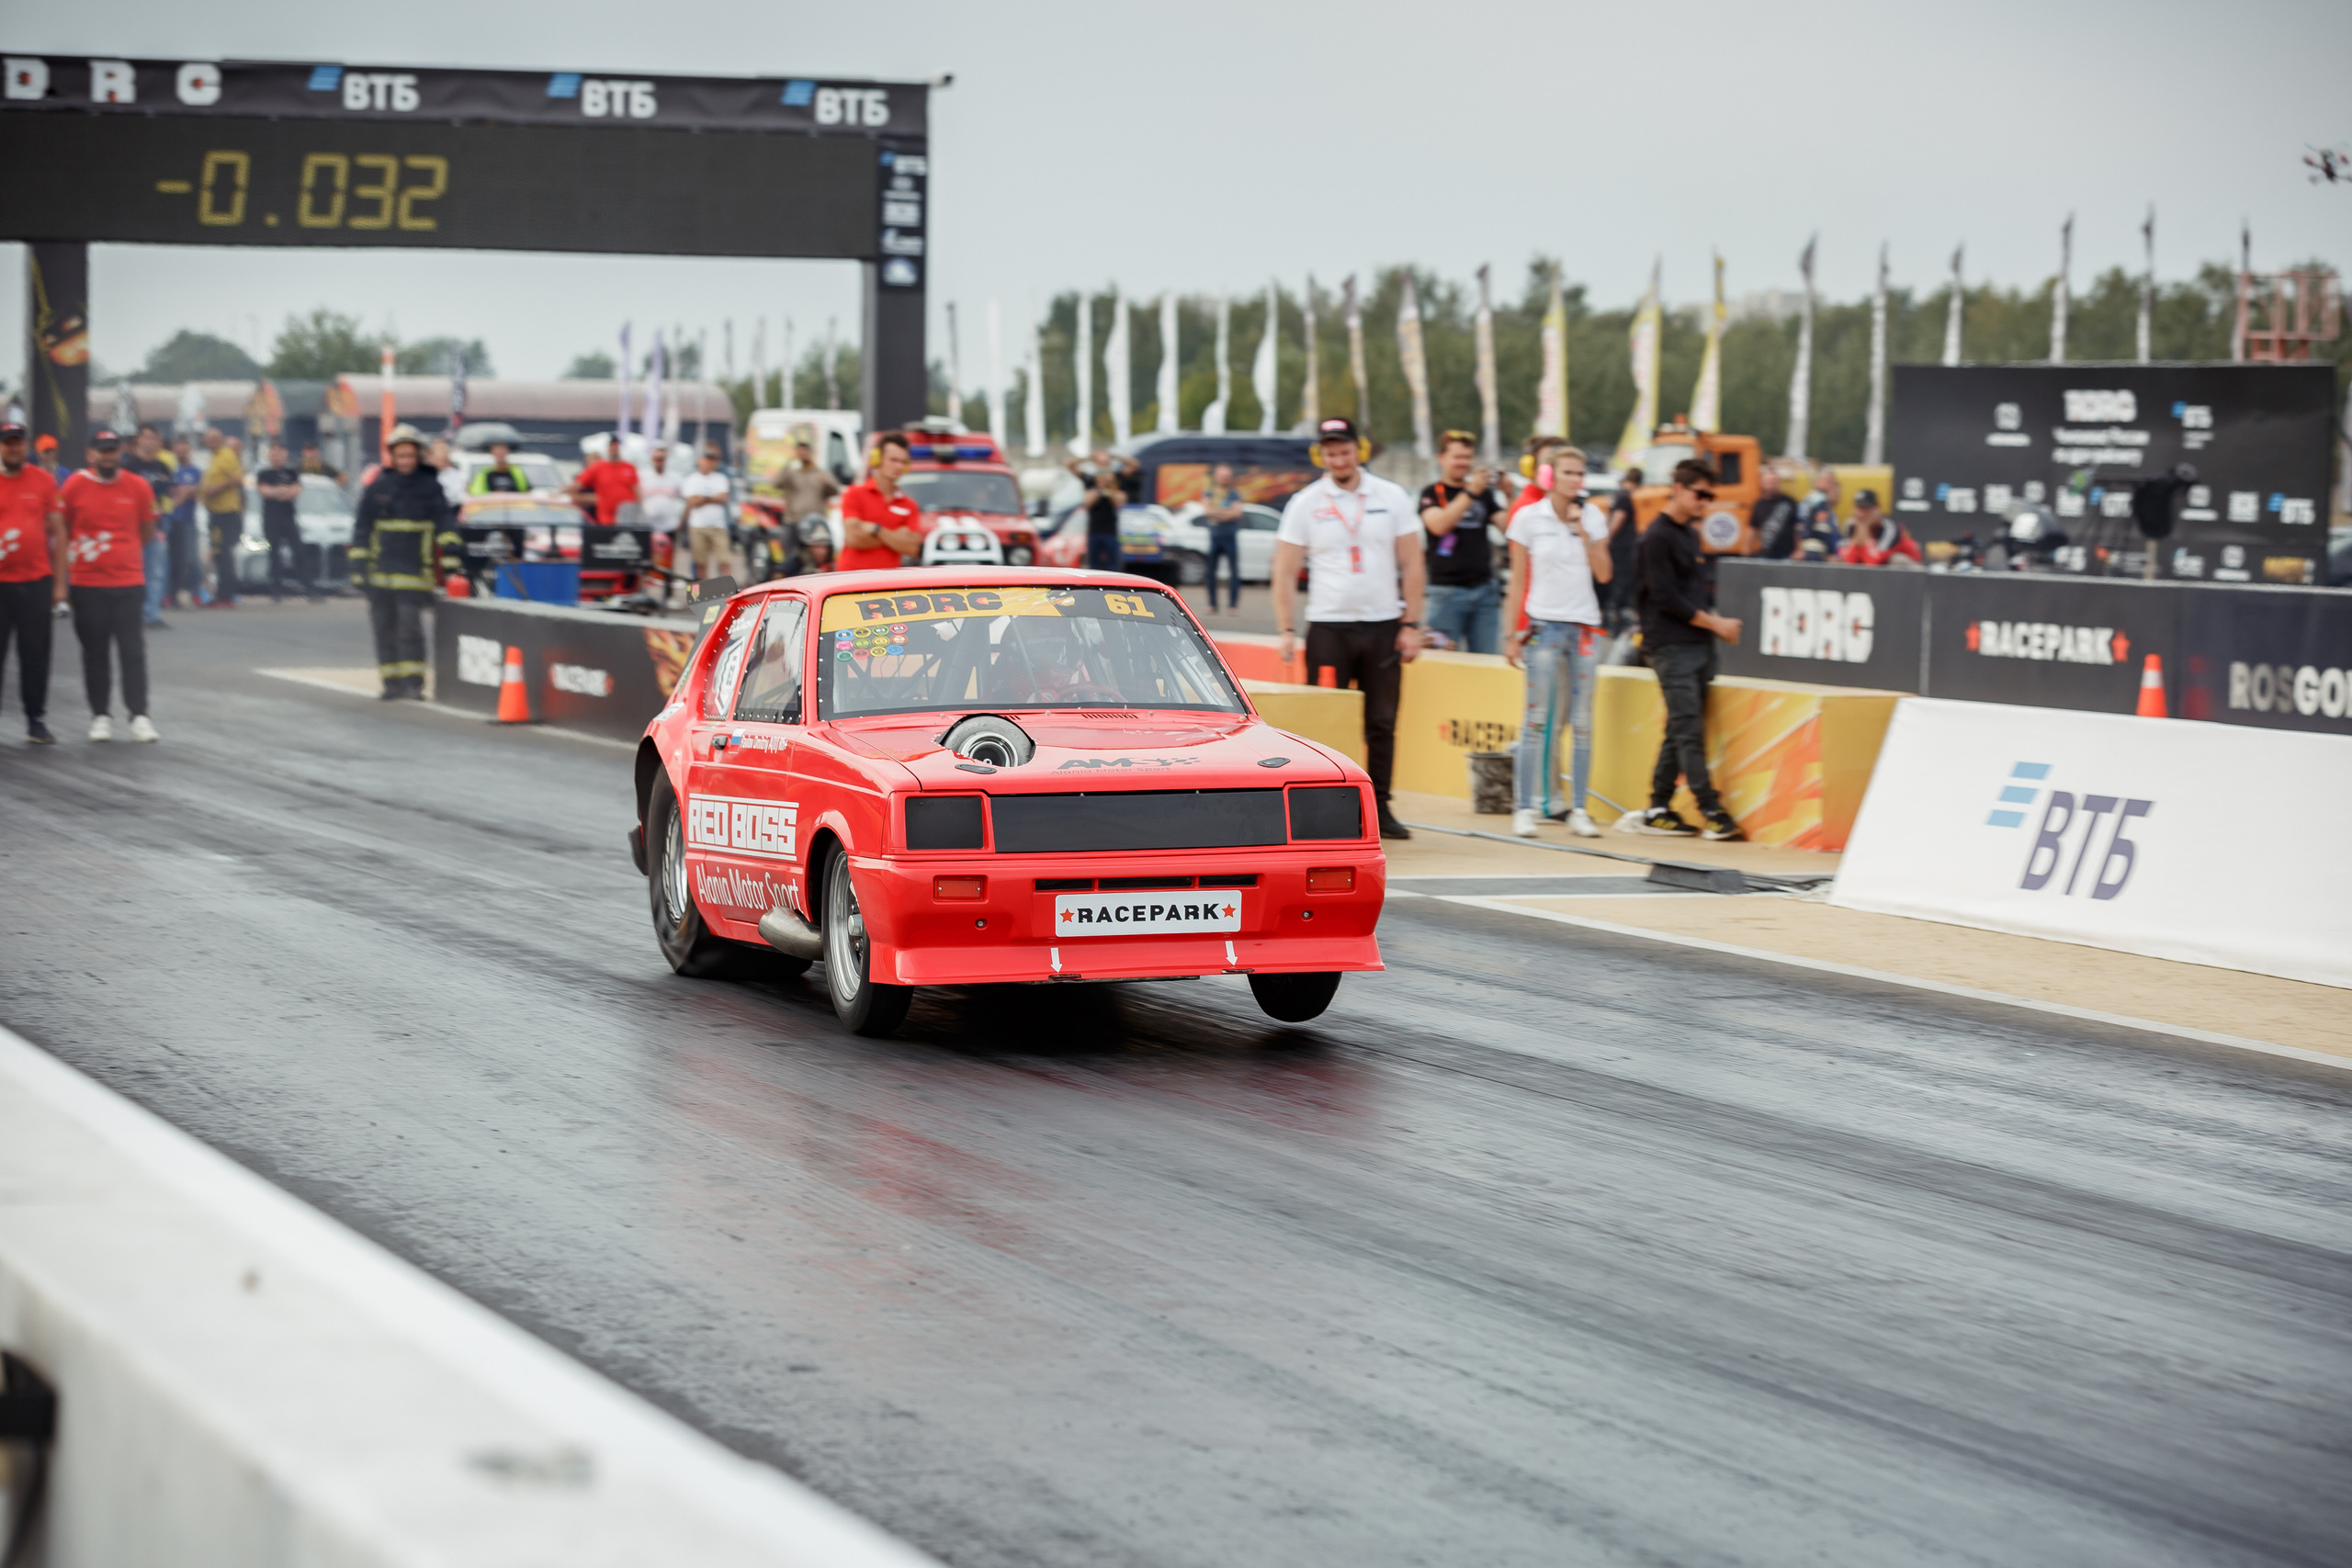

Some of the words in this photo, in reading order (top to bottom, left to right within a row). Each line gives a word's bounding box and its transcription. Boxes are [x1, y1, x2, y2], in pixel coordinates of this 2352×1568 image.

[343, 73, 420, 112] ВТБ
[581, 79, 658, 118] ВТБ
[814, 87, 890, 127] ВТБ
[155, 150, 450, 231] -0.032
[854, 592, 1003, 621] RDRC
[1103, 592, 1156, 618] 61
[1759, 586, 1874, 664] RDRC
[1978, 620, 2114, 665] RACEPARK
[688, 798, 729, 846] RED
[731, 803, 797, 854] BOSS
[2018, 790, 2156, 901] ВТБ
[695, 862, 734, 907] Alania
[728, 867, 769, 910] Motor
[1077, 903, 1220, 924] RACEPARK
